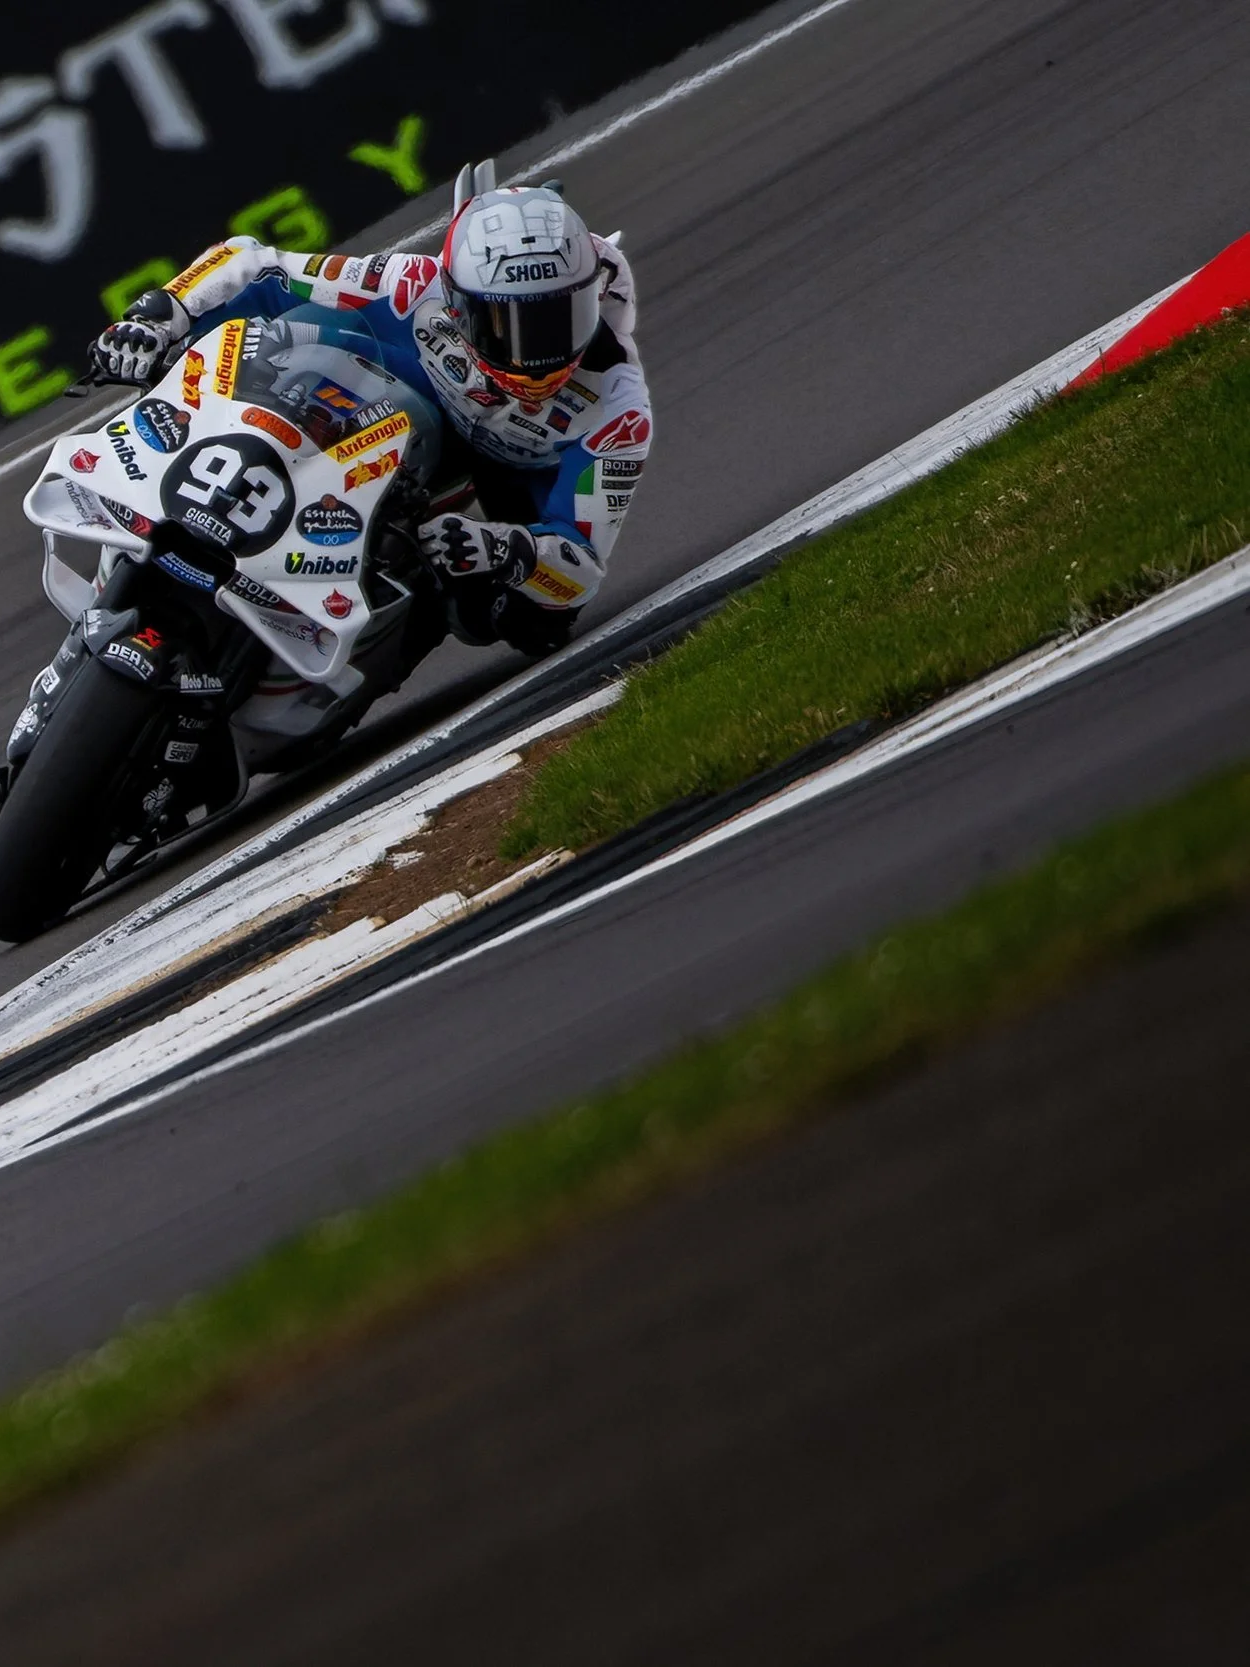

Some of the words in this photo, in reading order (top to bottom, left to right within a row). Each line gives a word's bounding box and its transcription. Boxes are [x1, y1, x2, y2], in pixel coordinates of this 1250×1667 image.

[504, 261, 559, 283] SHOEI
[519, 293, 543, 303] YOU
[213, 322, 241, 396] Antangin
[242, 326, 262, 361] MARC
[356, 399, 395, 428] MARC
[106, 420, 148, 483] Unibat
[334, 413, 409, 461] Antangin
[604, 460, 638, 471] BOLD
[177, 444, 286, 534] 93
[185, 507, 233, 543] GIGETTA
[284, 552, 358, 575] Unibat
[235, 575, 280, 604] BOLD
[533, 569, 579, 600] ntangin
